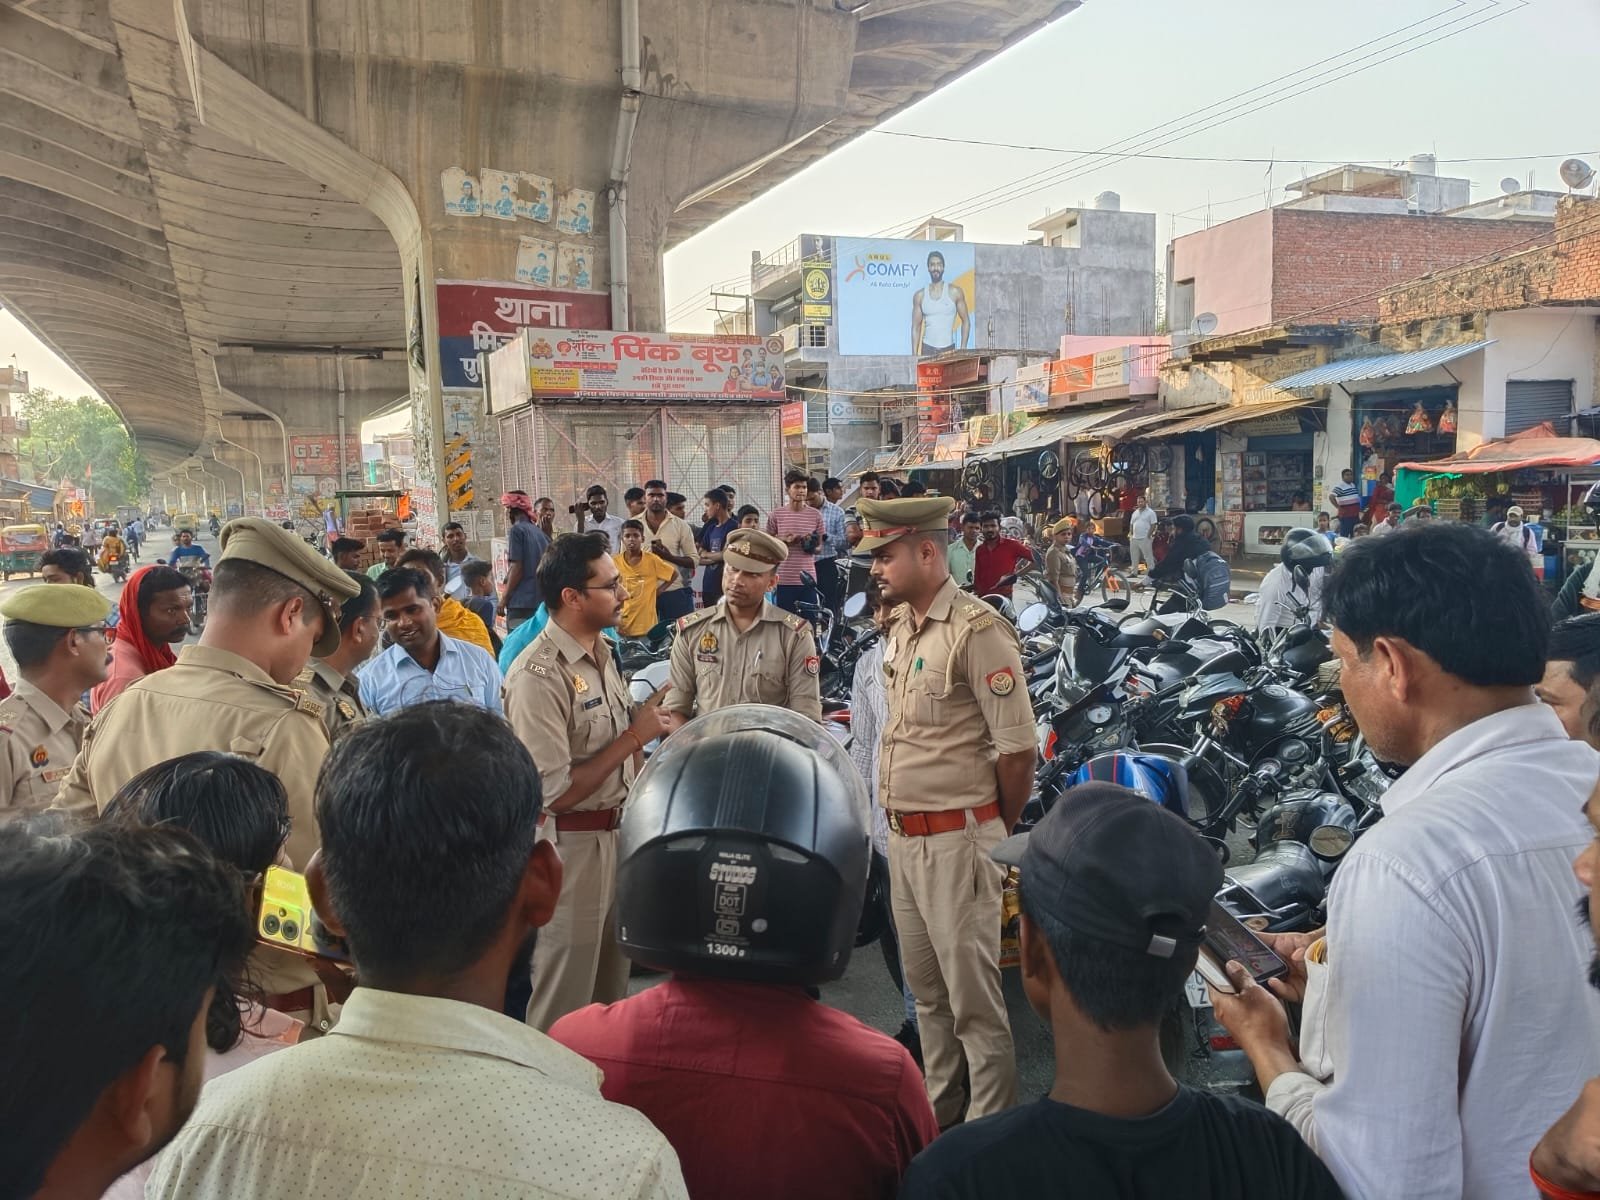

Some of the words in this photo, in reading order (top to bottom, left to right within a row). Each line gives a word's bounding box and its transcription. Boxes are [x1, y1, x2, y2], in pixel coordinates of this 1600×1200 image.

[866, 263, 919, 277] COMFY
[494, 296, 573, 327] थाना
[611, 334, 684, 361] पिंक
[690, 345, 741, 373] बूथ
[709, 862, 757, 885] STUDDS
[719, 895, 741, 907] DOT
[706, 943, 738, 956] 1300
